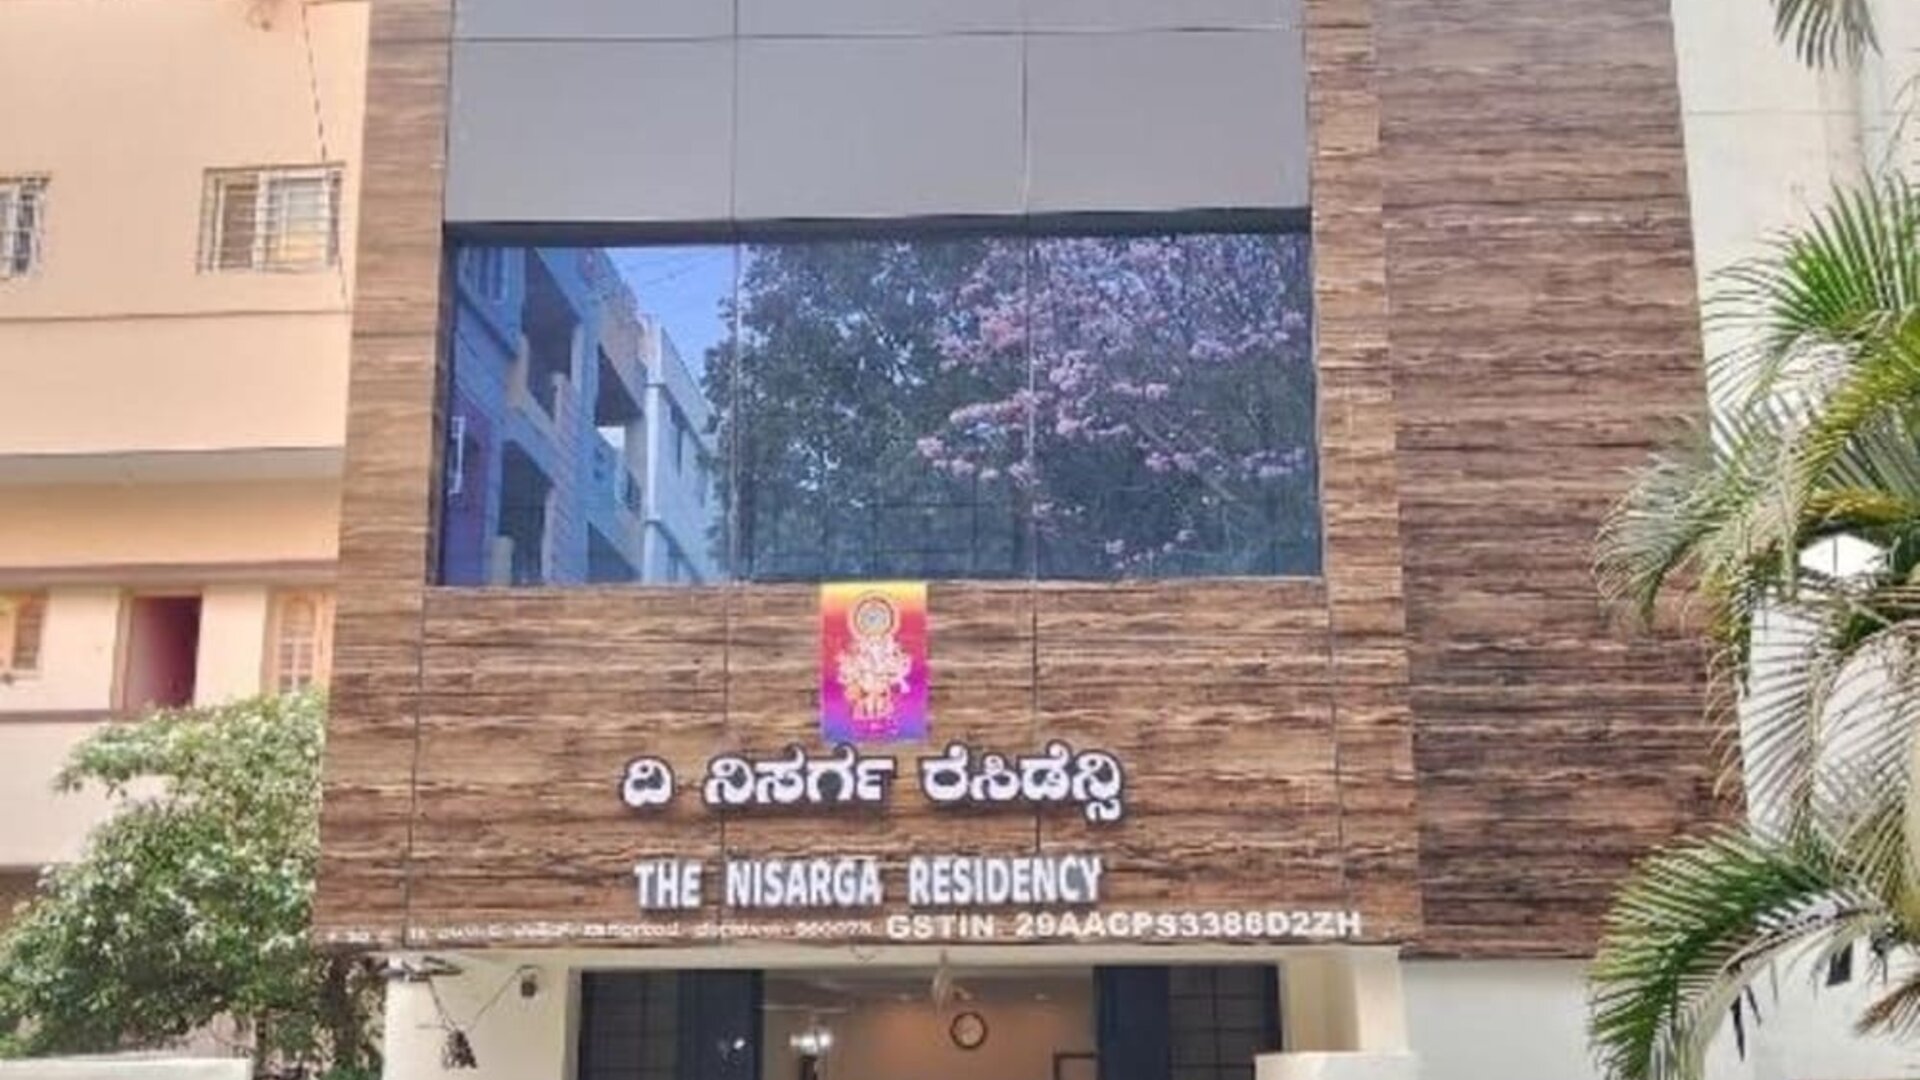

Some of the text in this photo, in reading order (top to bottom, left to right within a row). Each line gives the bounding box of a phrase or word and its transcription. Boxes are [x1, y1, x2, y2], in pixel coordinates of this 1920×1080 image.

[622, 756, 673, 808] ದಿ
[704, 745, 894, 805] ನಿಸರ್ಗ
[634, 856, 1102, 908] THE NISARGA RESIDENCY
[886, 914, 994, 939] GSTIN
